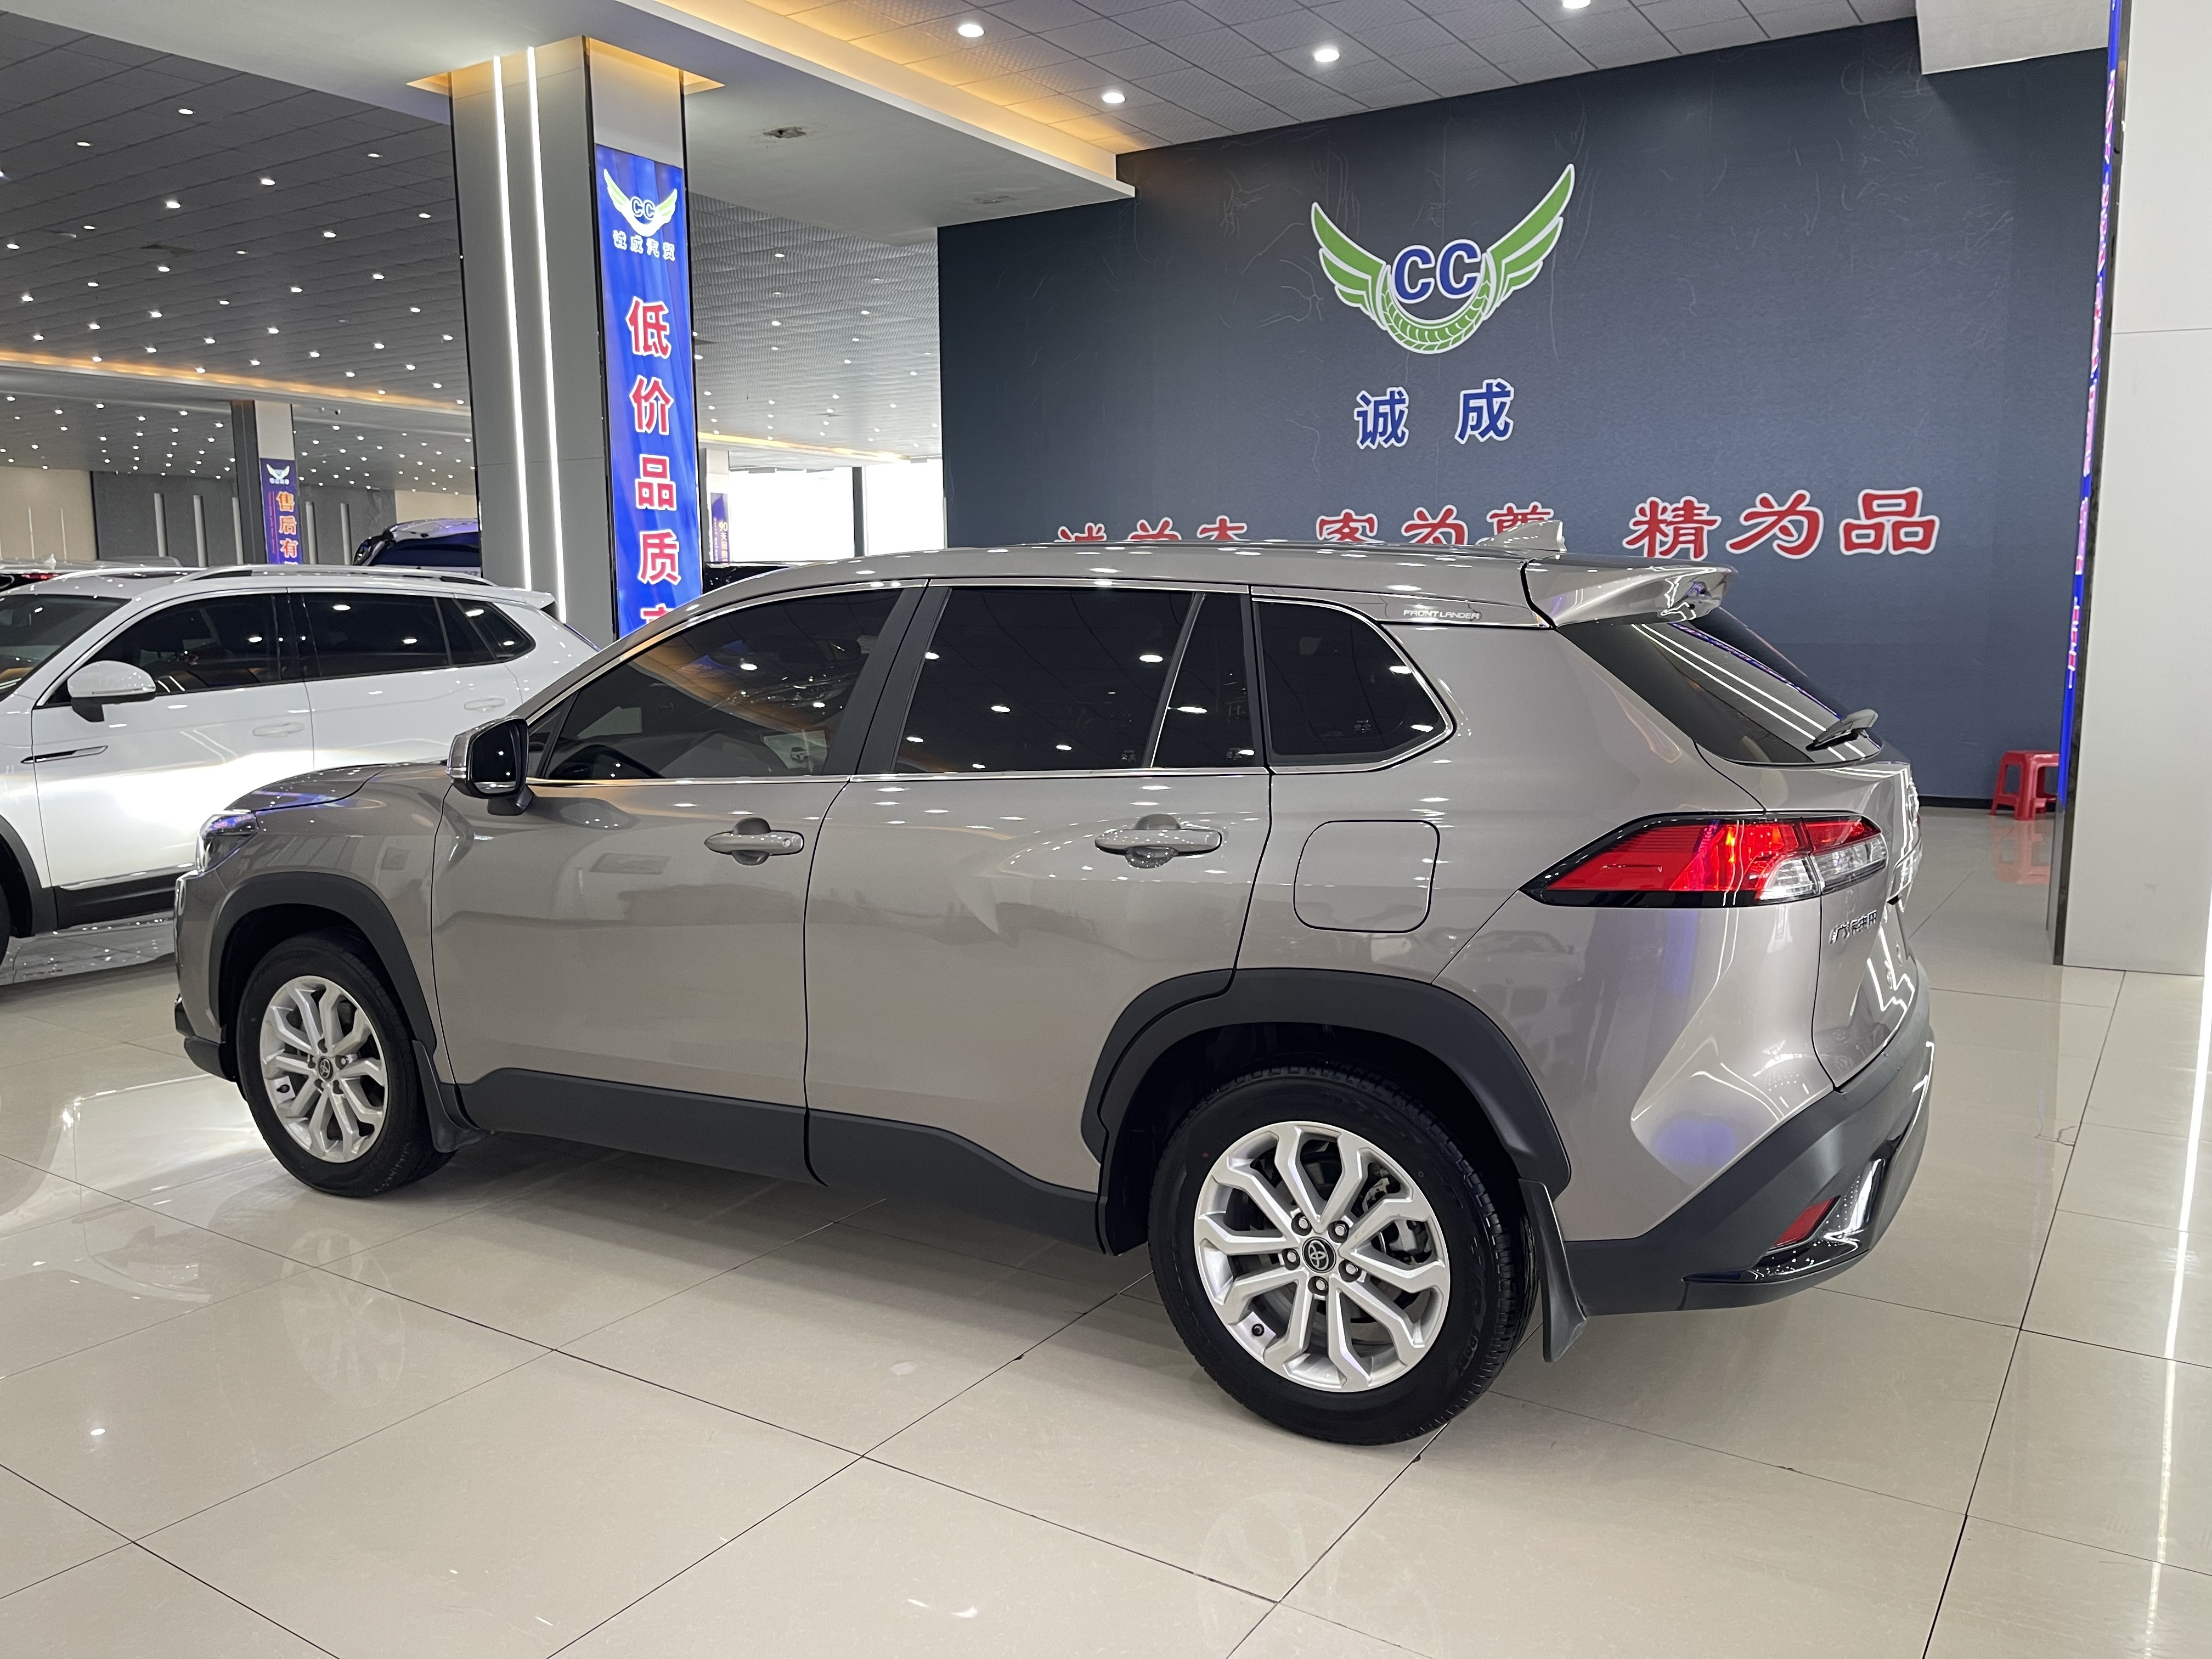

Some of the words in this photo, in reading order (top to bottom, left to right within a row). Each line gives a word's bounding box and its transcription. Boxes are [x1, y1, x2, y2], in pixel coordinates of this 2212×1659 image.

[630, 196, 656, 221] CC
[613, 230, 675, 261] 诚成汽贸
[1392, 239, 1481, 304] CC
[276, 491, 299, 565] 售后有
